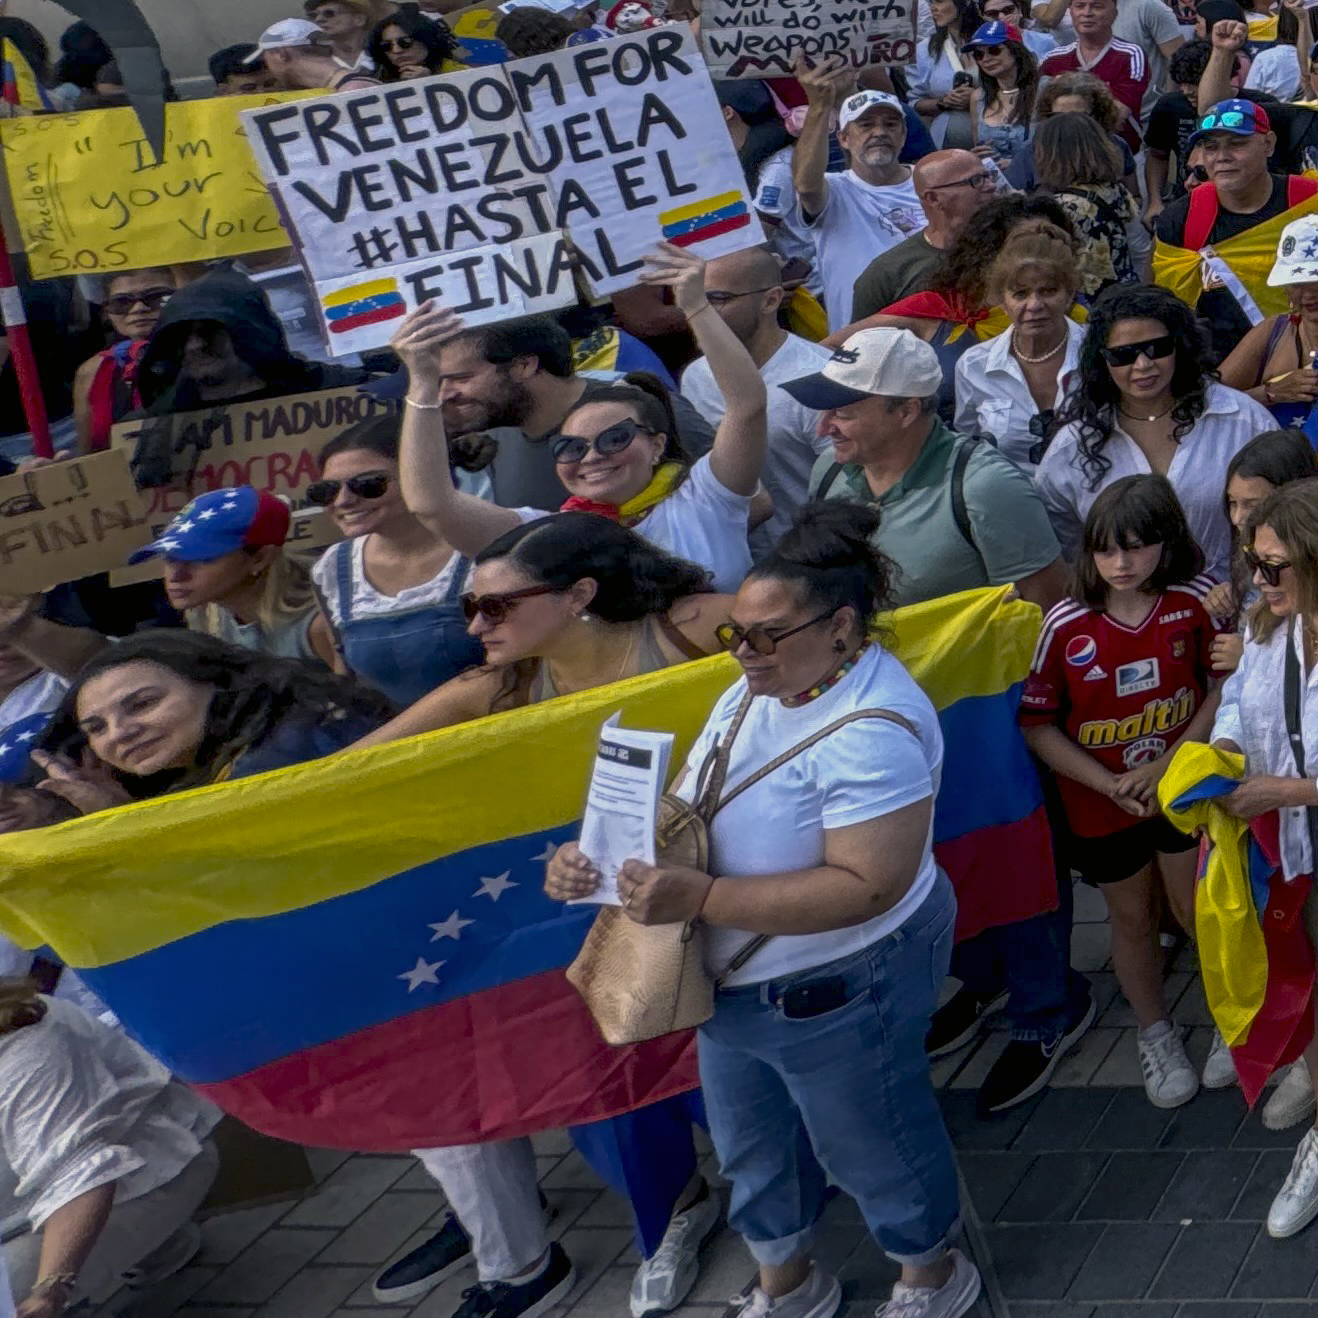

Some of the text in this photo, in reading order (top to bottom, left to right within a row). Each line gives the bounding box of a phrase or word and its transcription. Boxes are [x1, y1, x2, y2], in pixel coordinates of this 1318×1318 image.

[782, 10, 821, 30] do
[254, 31, 693, 176] FREEDOM FOR
[90, 172, 222, 230] your
[290, 93, 687, 223] VENEZUELA
[347, 149, 697, 269] #HASTA EL
[404, 228, 645, 314] FINAL
